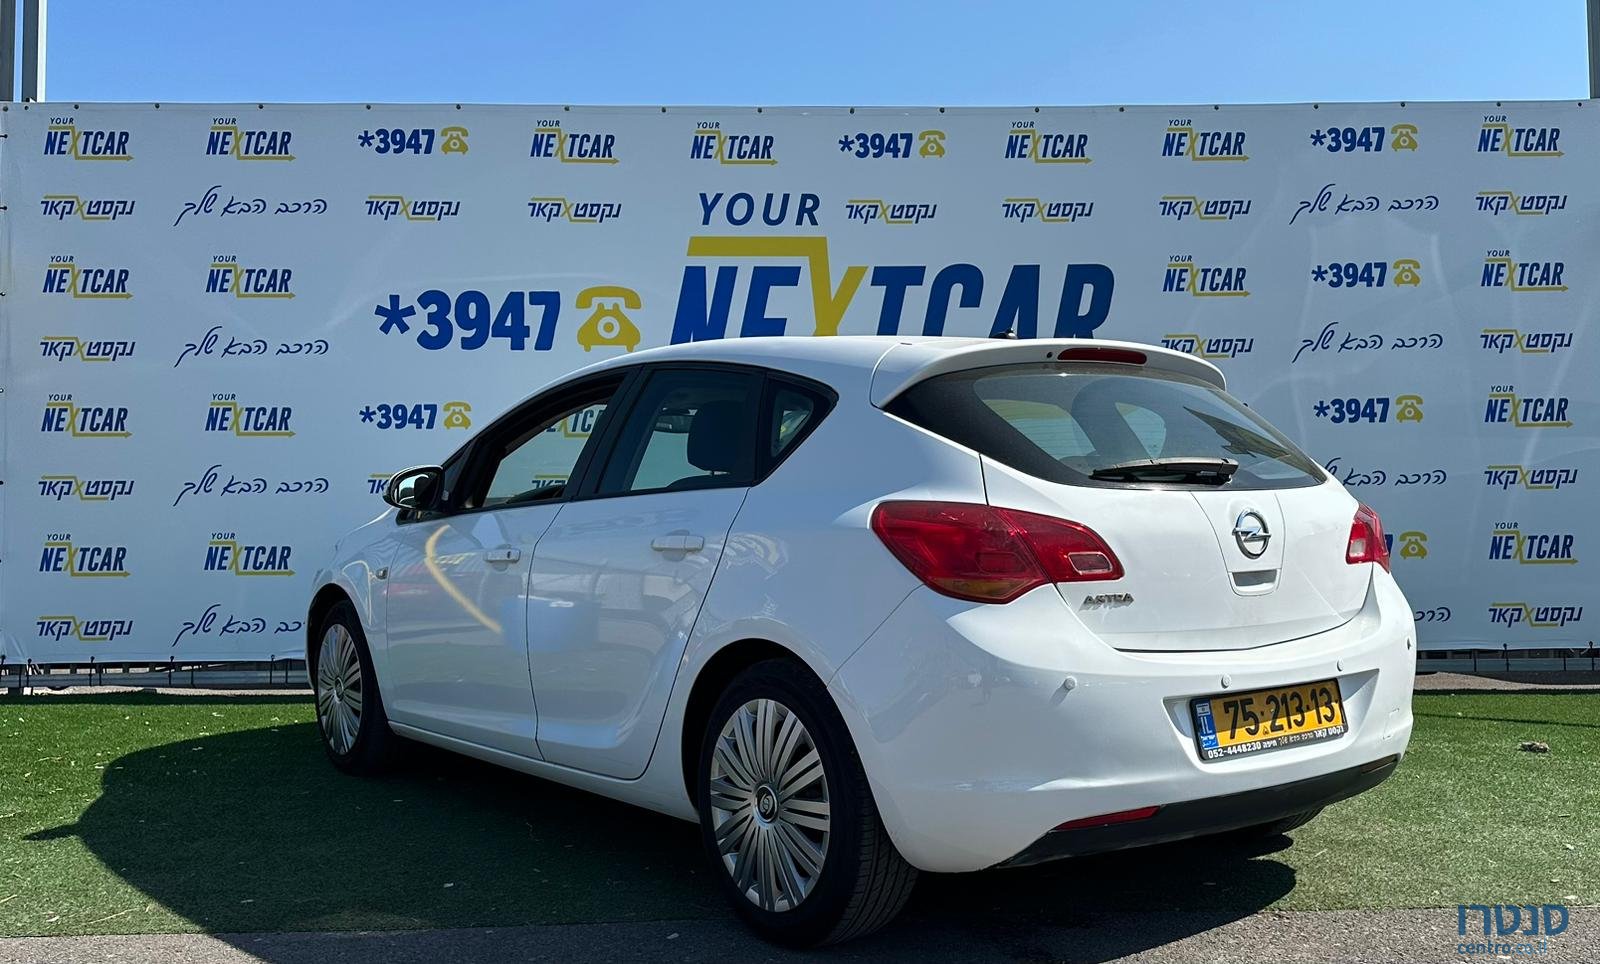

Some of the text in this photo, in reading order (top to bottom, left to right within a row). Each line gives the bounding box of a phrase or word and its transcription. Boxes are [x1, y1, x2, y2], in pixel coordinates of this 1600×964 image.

[537, 120, 559, 128] YOUR
[44, 131, 129, 155] NEXTCAR
[206, 131, 291, 155] NEXTCAR
[530, 134, 615, 158] NEXTCAR
[691, 135, 773, 159] NEXTCAR
[1005, 134, 1087, 158] NEXTCAR
[1162, 132, 1245, 156] NEXTCAR
[1478, 128, 1560, 152] NEXTCAR
[173, 186, 327, 226] הרכב הבא שלך
[700, 193, 820, 226] YOUR
[1289, 184, 1439, 225] הרכב הבא שלך
[43, 269, 129, 293] NEXTCAR
[206, 269, 292, 292] NEXTCAR
[1163, 268, 1246, 292] NEXTCAR
[1481, 263, 1564, 287] NEXTCAR
[670, 264, 1115, 341] NEXTCAR
[173, 326, 328, 367] הרכב הבא שלך
[1292, 322, 1443, 363] הרכב הבא שלך
[41, 407, 128, 431] NEXTCAR
[205, 407, 291, 431] NEXTCAR
[1485, 398, 1568, 423] NEXTCAR
[173, 465, 328, 506] הרכב הבא שלך
[1343, 468, 1446, 486] הרכב הבא
[39, 547, 126, 571] NEXTCAR
[204, 546, 291, 570] NEXTCAR
[1489, 535, 1573, 559] NEXTCAR
[172, 604, 305, 647] כב הבא שלך
[1414, 607, 1451, 622] הרכ
